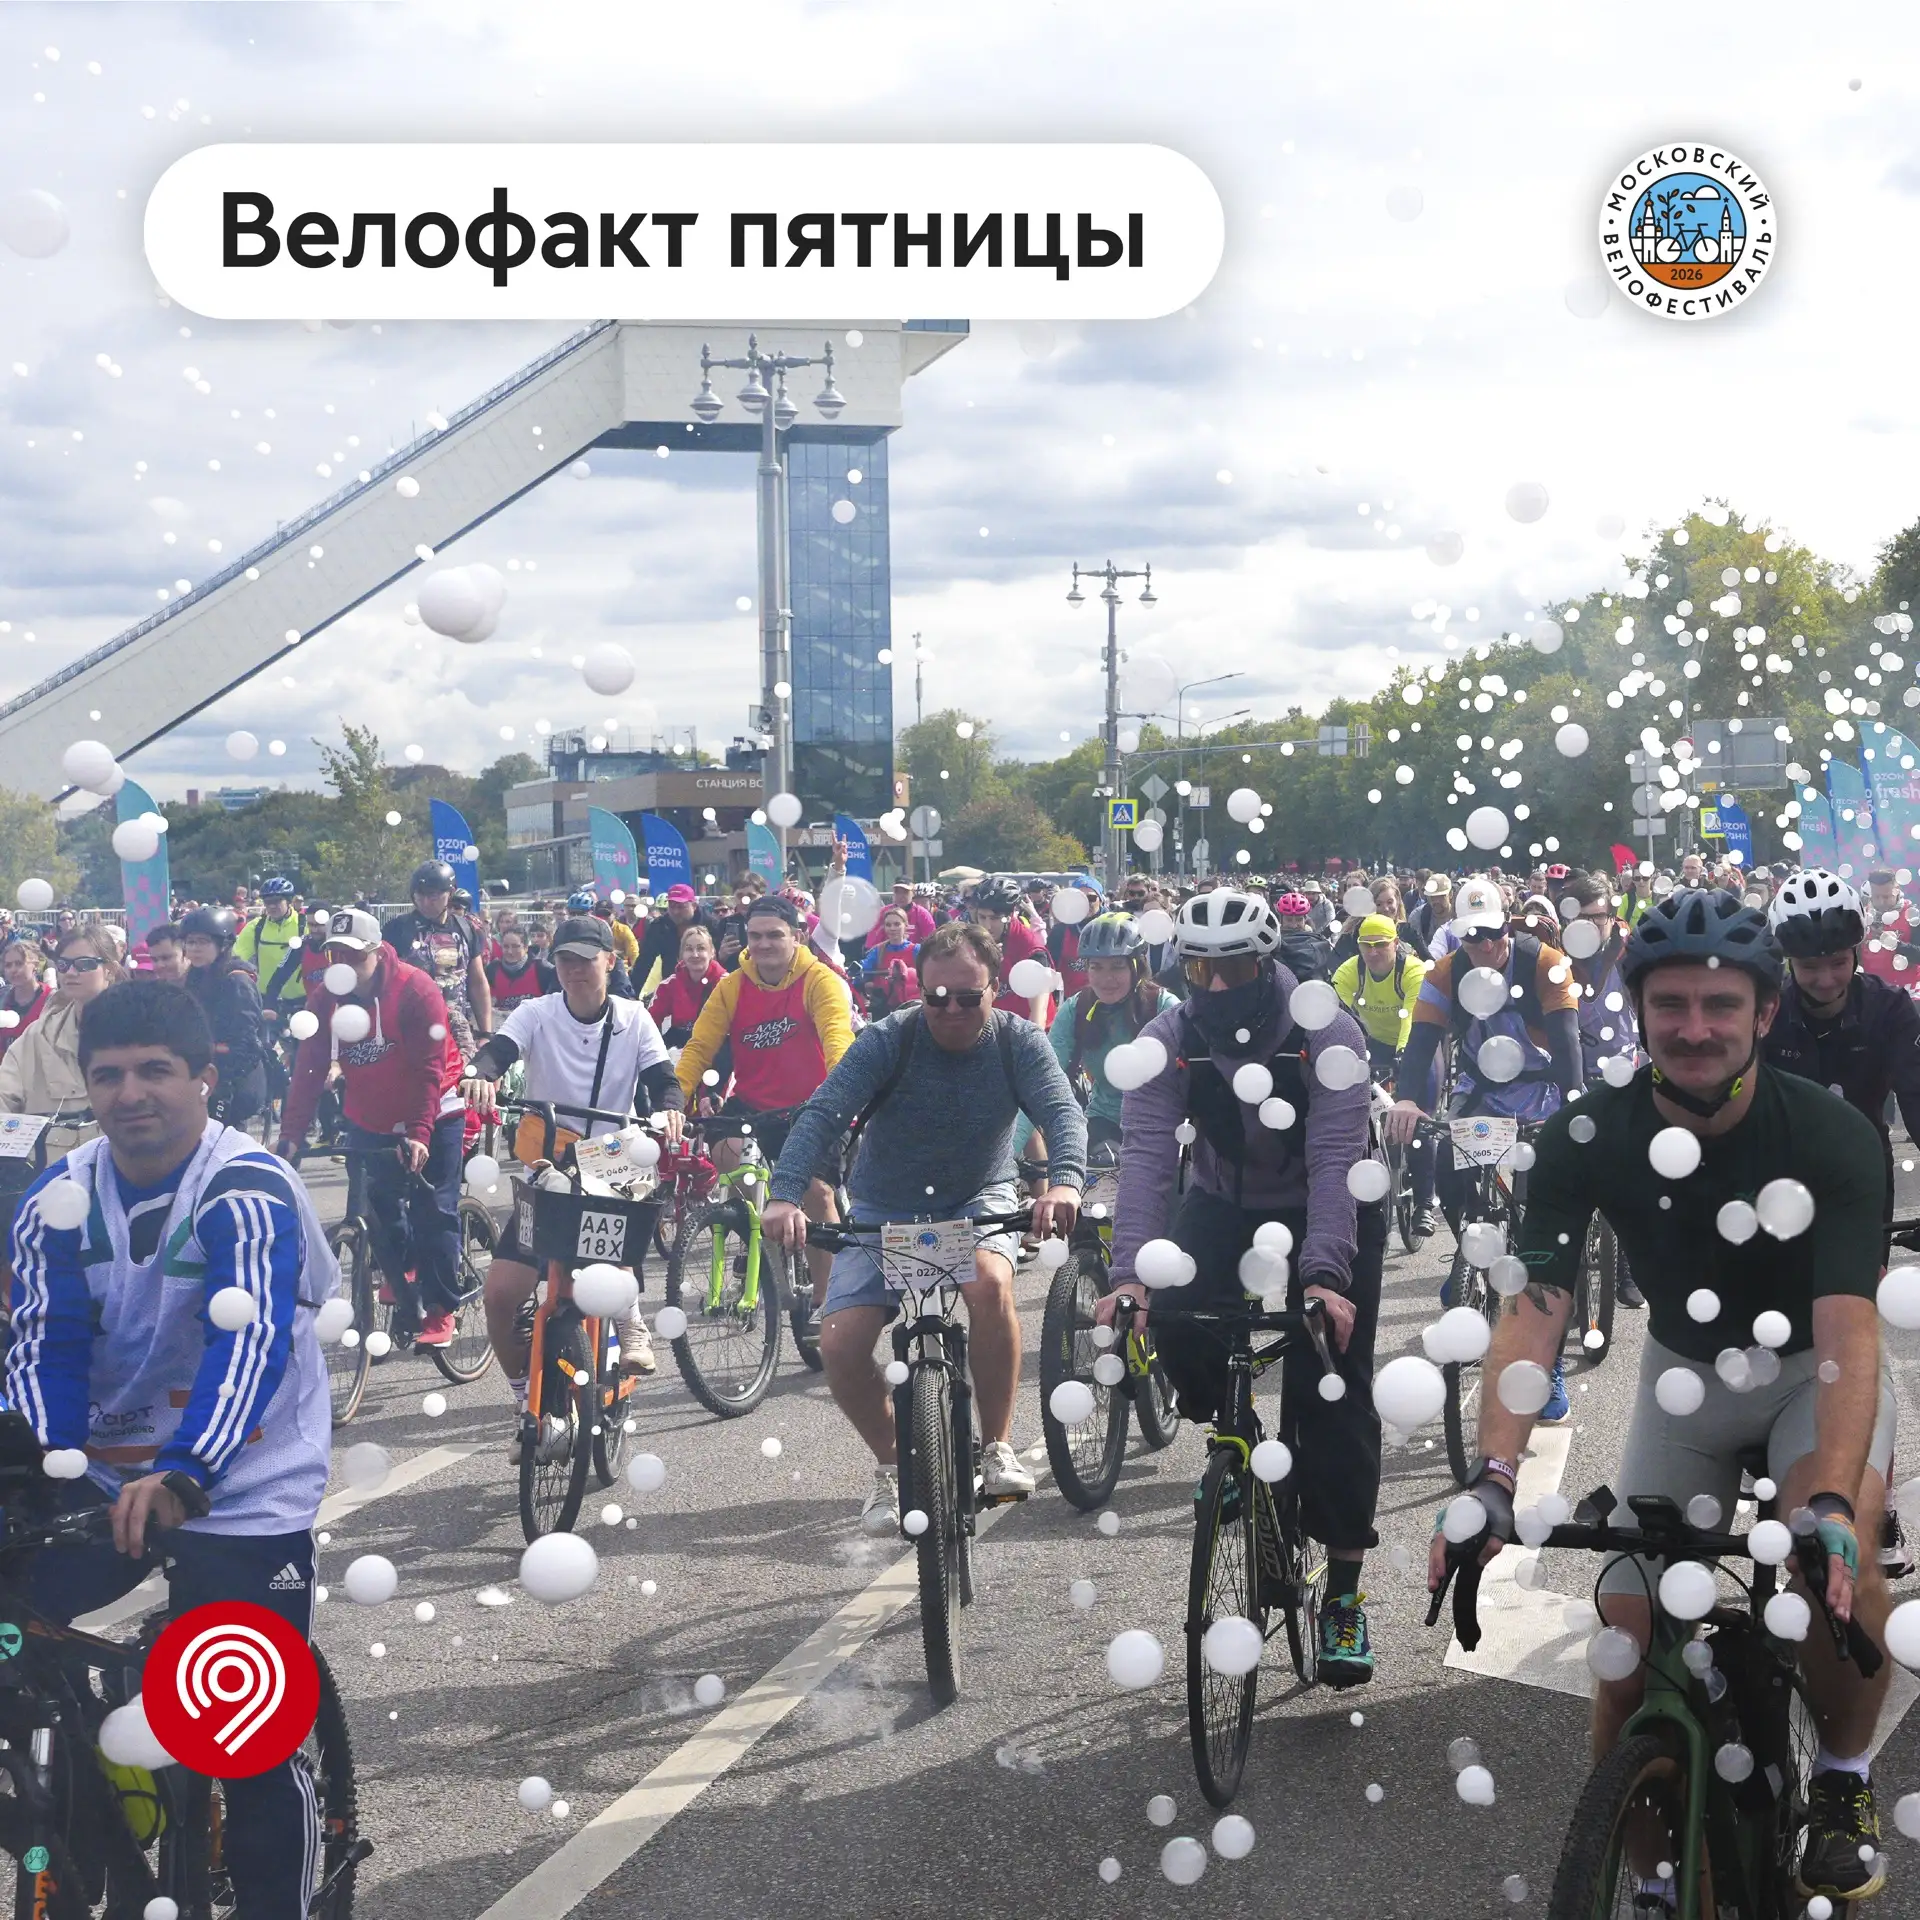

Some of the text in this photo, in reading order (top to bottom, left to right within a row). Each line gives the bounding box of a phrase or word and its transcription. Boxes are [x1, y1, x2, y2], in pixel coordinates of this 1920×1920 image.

[696, 779, 747, 789] СТАНЦИЯ
[1801, 821, 1828, 834] fresh
[846, 841, 865, 849] zon
[594, 848, 627, 863] fresh
[647, 846, 682, 857] ozon
[847, 851, 866, 860] анк
[648, 855, 683, 869] банк
[606, 1165, 629, 1178] 0469
[269, 1579, 306, 1590] adidas
